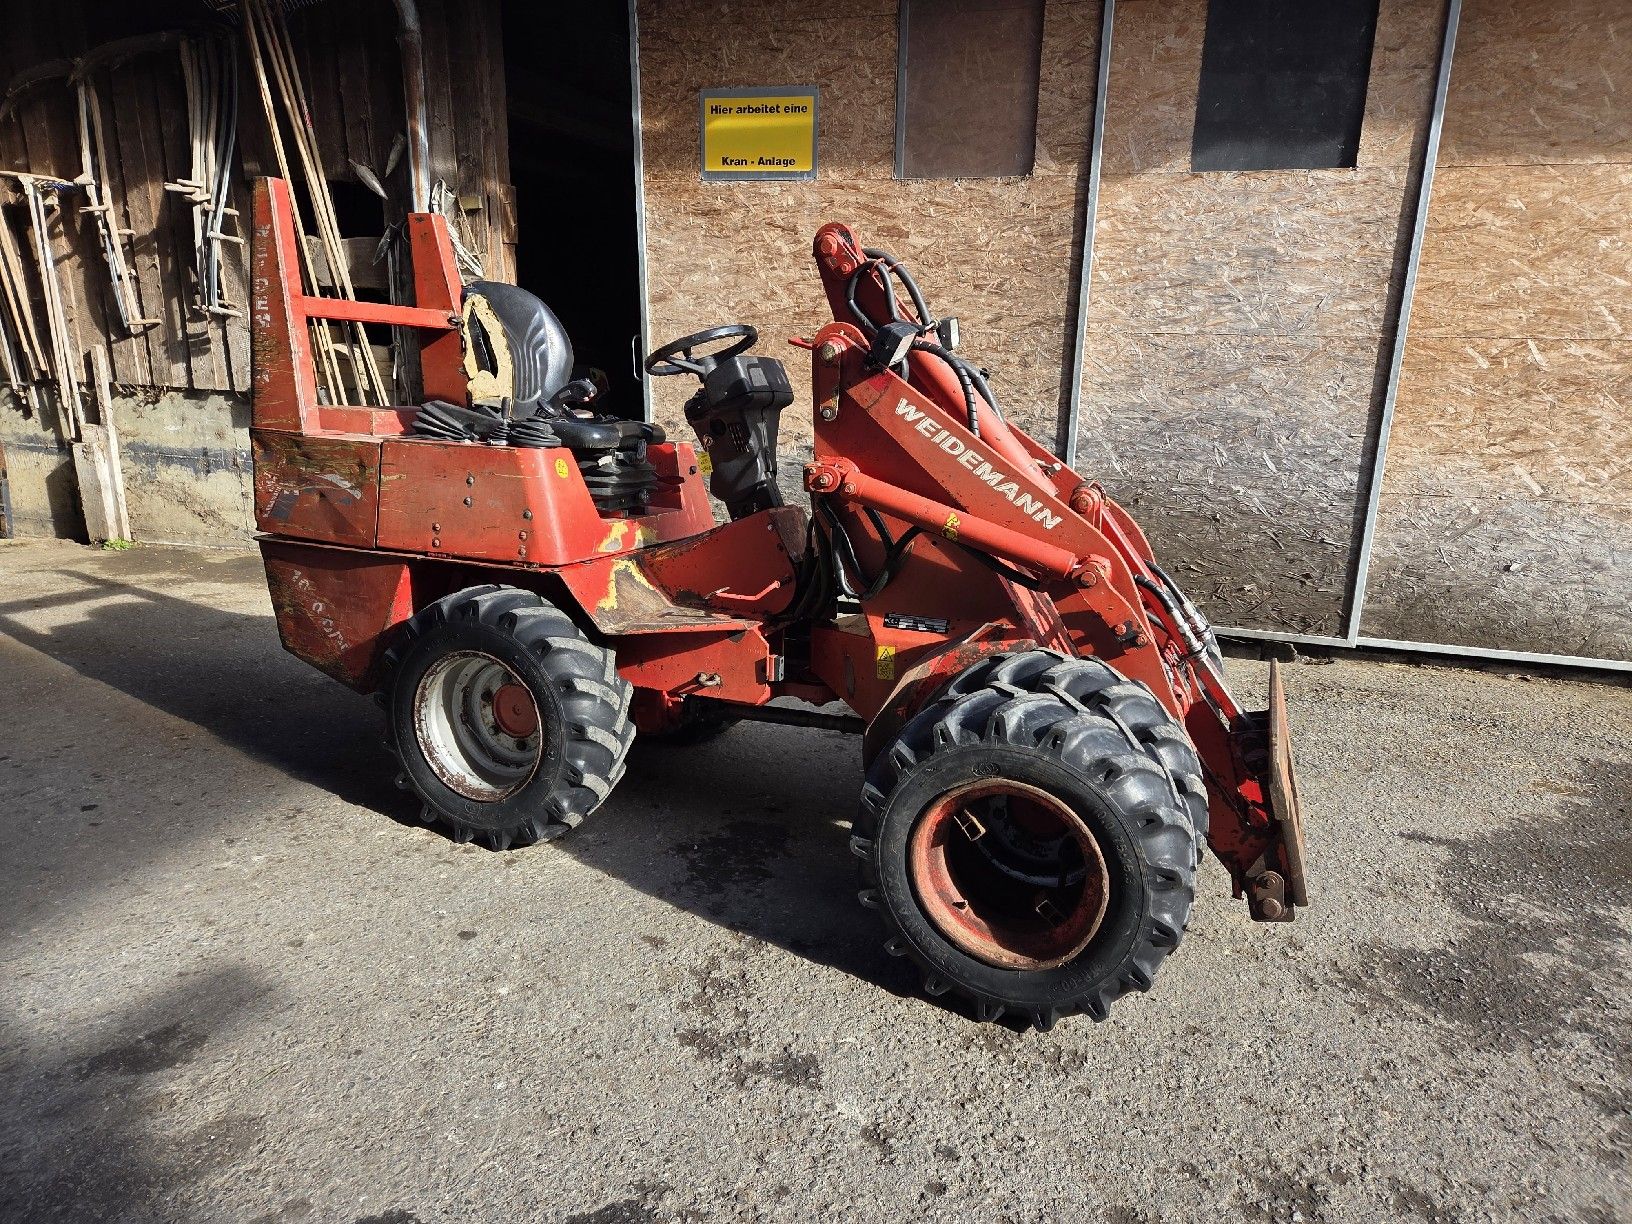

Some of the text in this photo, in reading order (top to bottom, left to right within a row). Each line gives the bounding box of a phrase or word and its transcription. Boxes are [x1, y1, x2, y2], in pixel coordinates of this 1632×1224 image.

[710, 104, 808, 115] Hier arbeitet eine
[721, 157, 748, 166] Kran
[757, 157, 796, 167] Anlage
[895, 397, 1063, 530] WEIDEMANN
